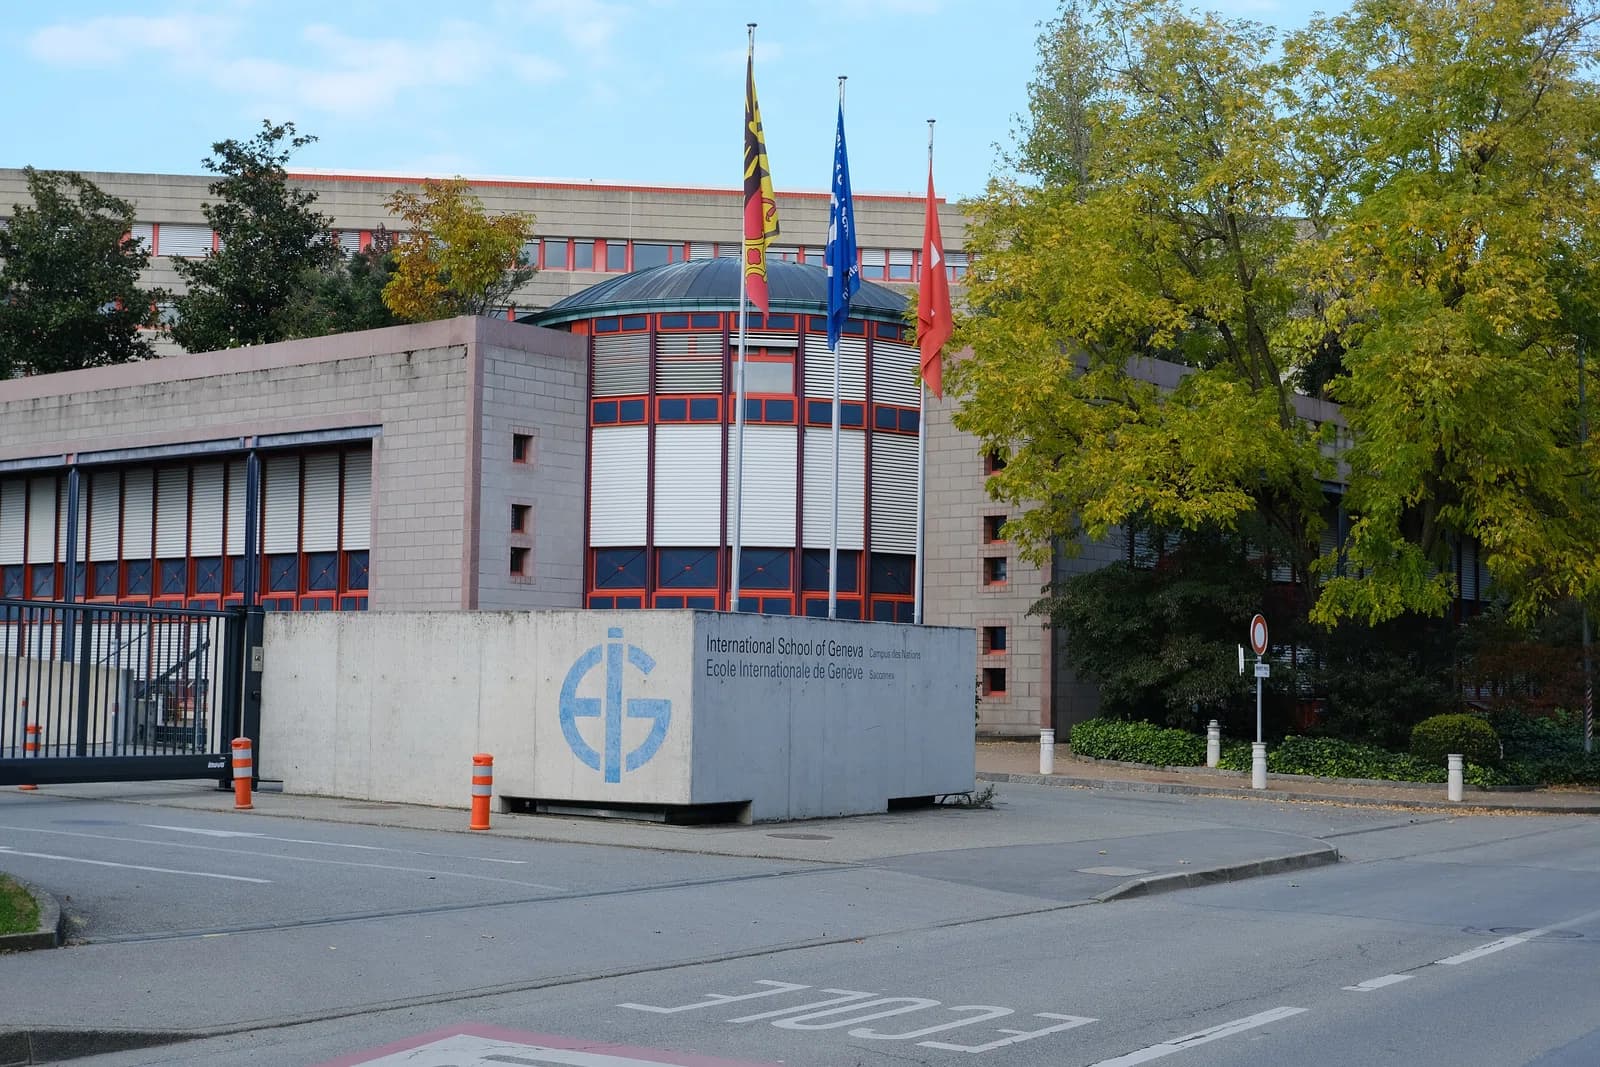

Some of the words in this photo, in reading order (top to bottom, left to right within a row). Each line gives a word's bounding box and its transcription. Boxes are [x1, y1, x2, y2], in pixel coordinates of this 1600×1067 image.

[706, 634, 775, 654] International
[778, 637, 812, 656] School
[815, 640, 826, 656] of
[828, 640, 864, 658] Geneva
[870, 648, 891, 660] Campus
[901, 649, 921, 660] Nations
[706, 659, 737, 677] Ecole
[739, 660, 811, 679] Internationale
[813, 662, 825, 679] de
[827, 662, 864, 680] Genève
[616, 979, 1099, 1053] ECOLE
